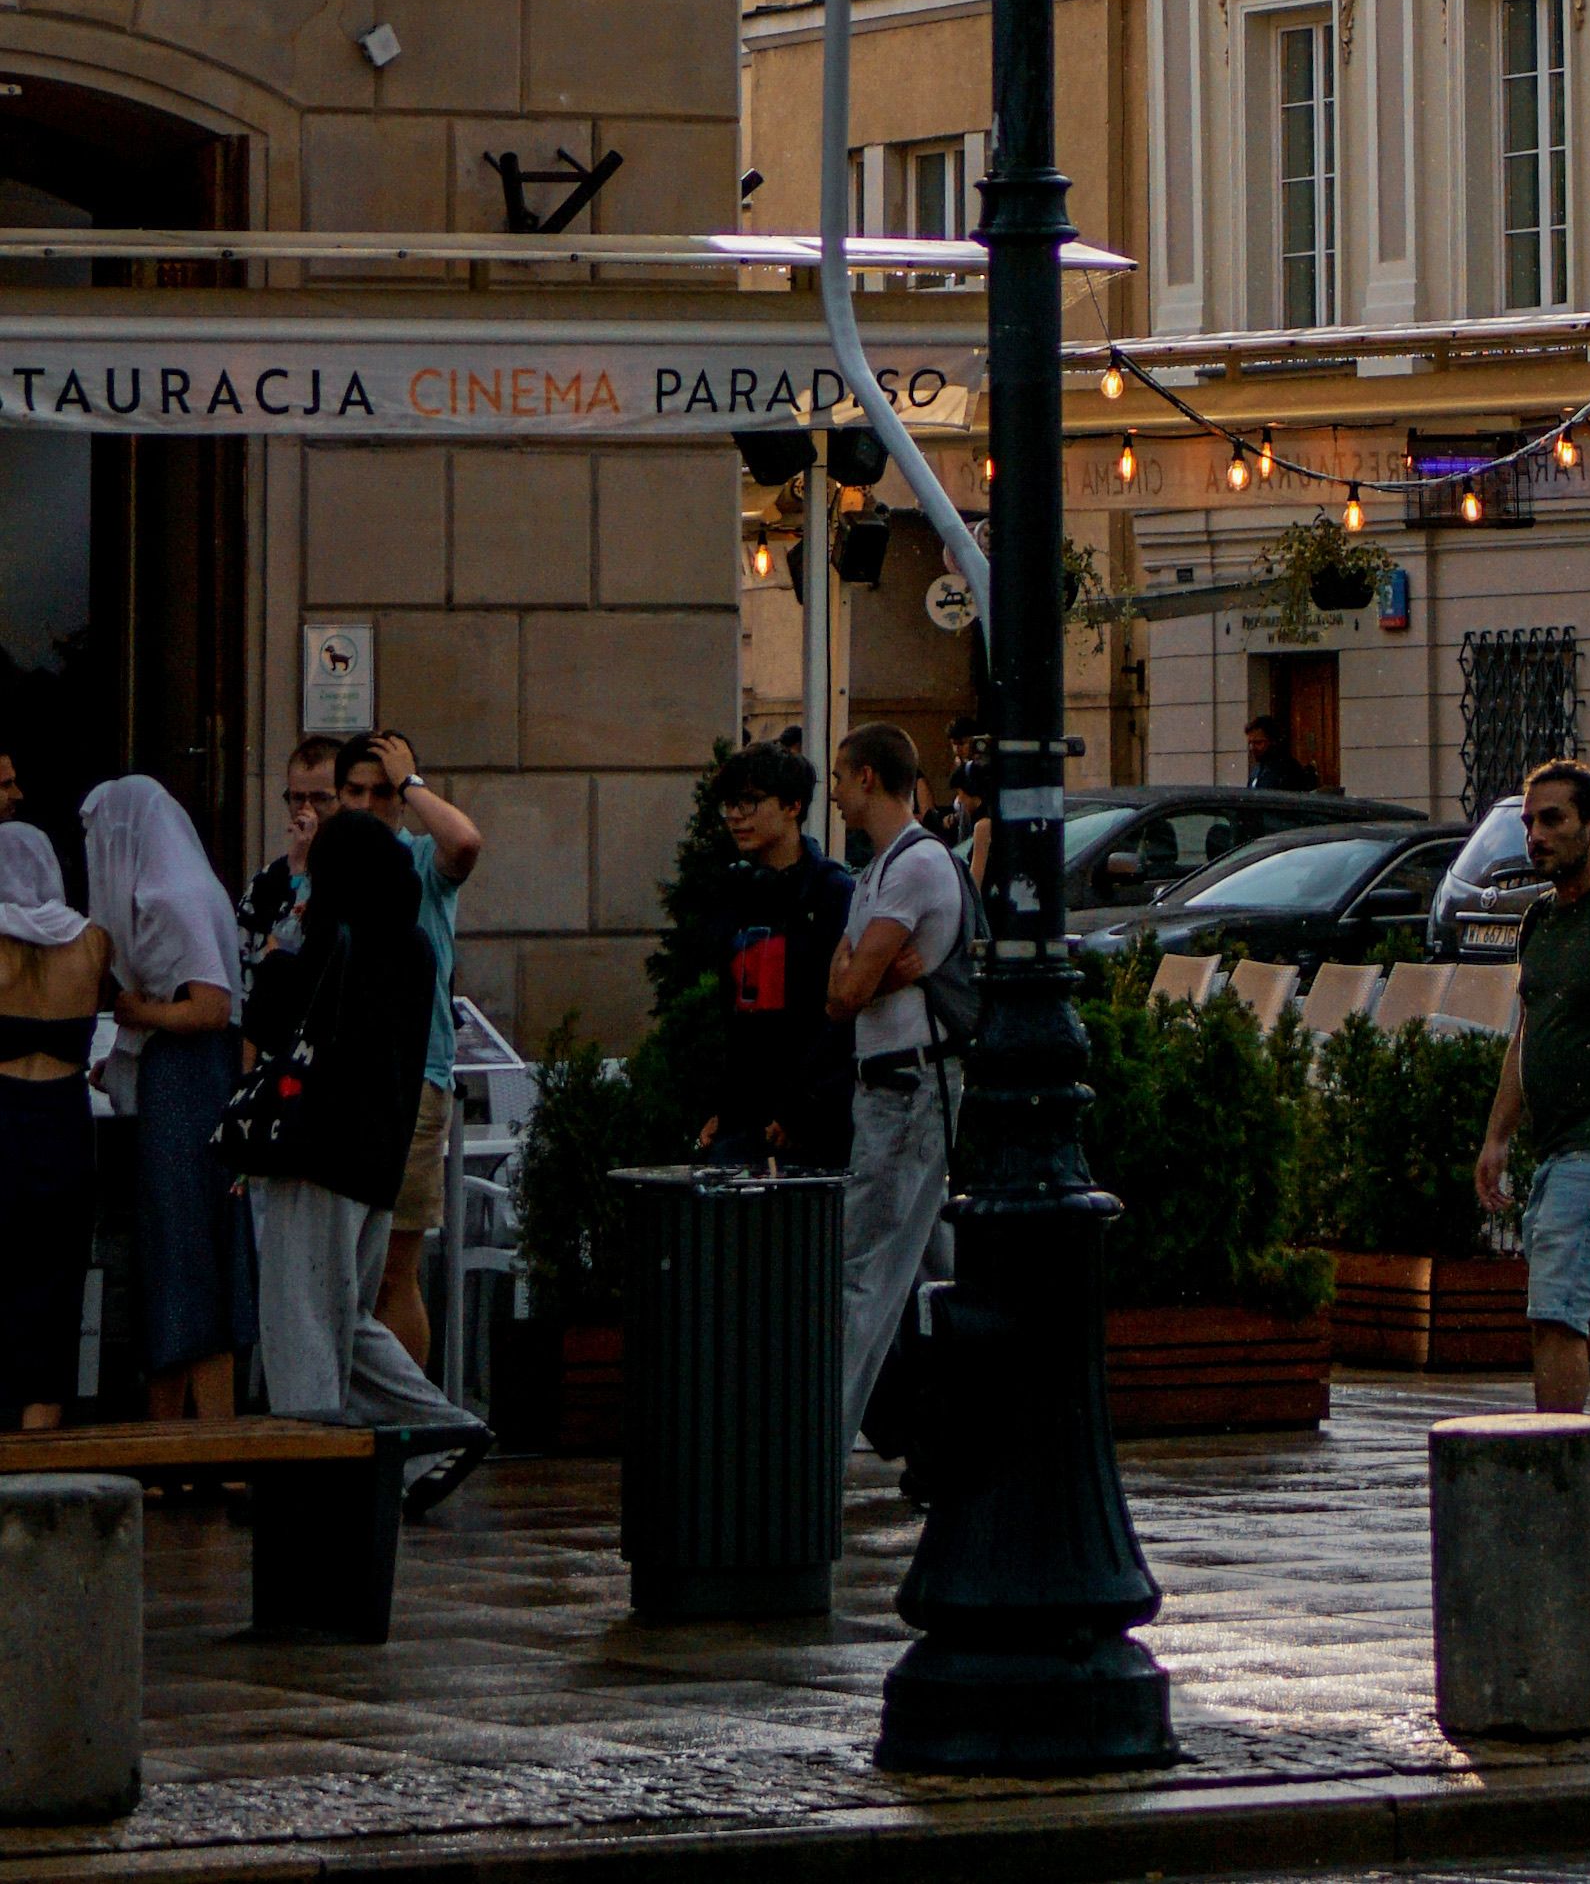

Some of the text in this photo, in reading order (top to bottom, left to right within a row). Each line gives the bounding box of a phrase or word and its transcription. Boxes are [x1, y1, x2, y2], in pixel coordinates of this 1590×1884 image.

[0, 367, 947, 417] TAURACJA CINEMA PARADSO
